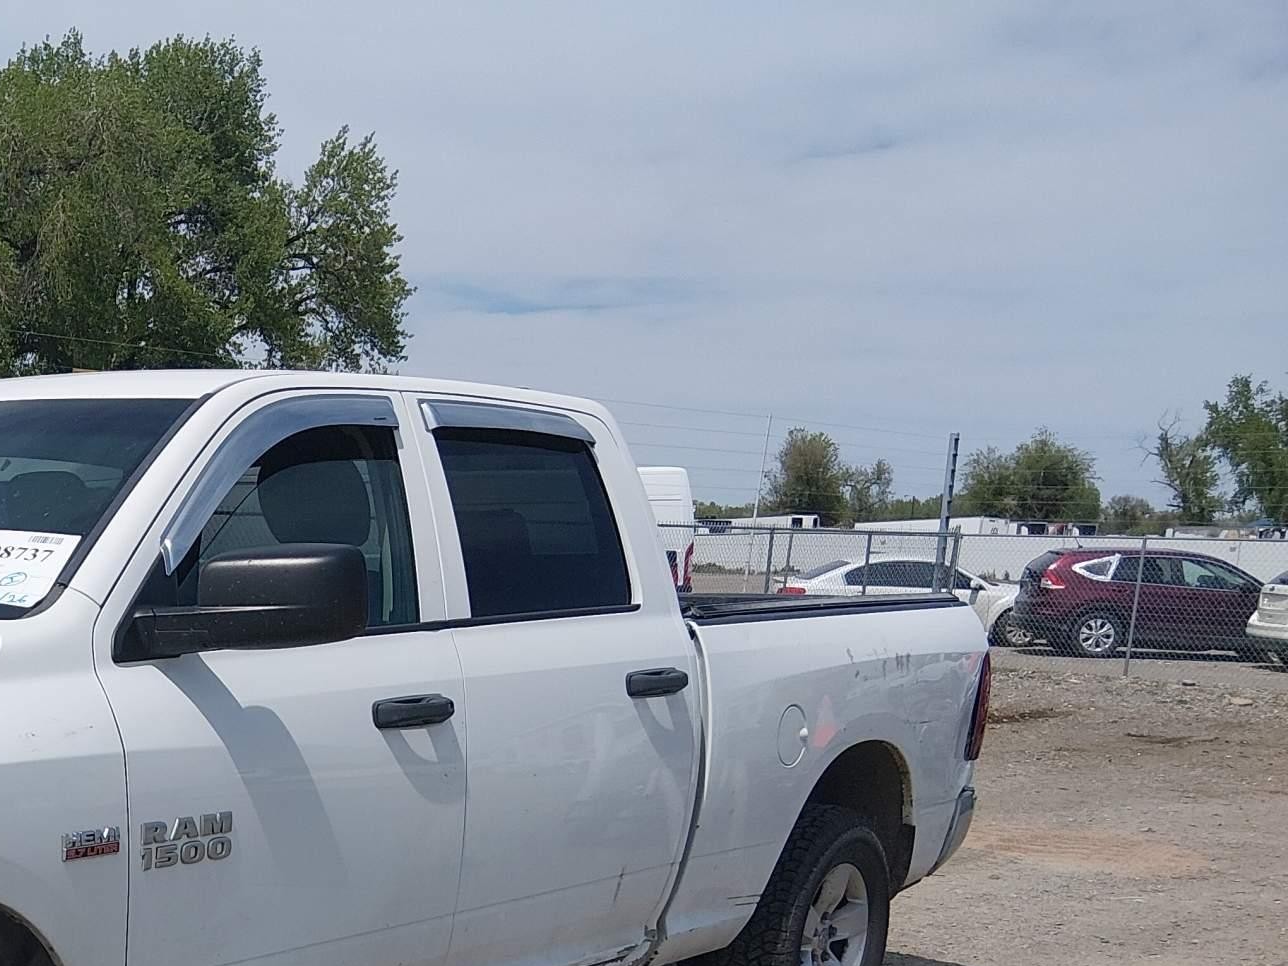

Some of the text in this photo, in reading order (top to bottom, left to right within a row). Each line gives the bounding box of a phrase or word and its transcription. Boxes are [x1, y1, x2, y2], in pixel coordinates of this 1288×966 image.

[62, 826, 120, 849] HEMI
[141, 811, 232, 846] RAM
[141, 836, 232, 872] 1500
